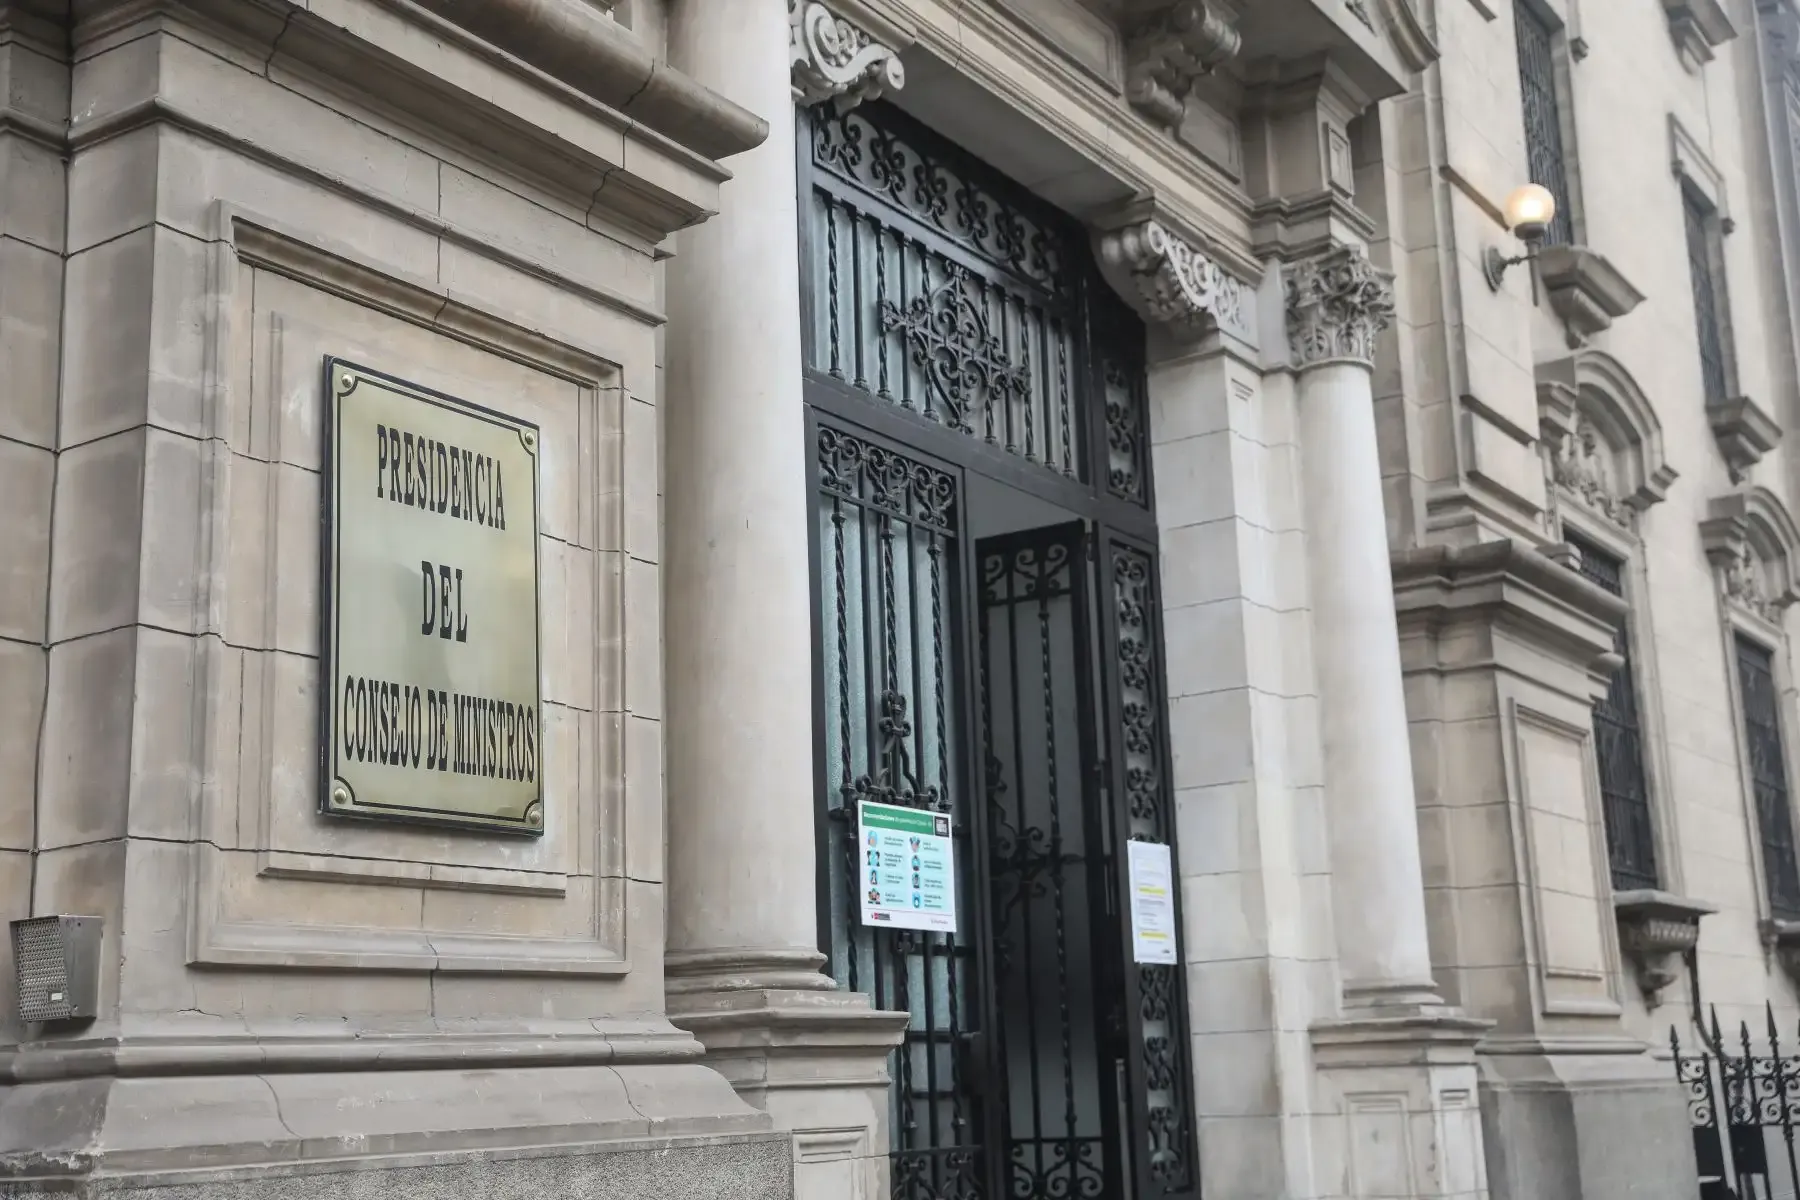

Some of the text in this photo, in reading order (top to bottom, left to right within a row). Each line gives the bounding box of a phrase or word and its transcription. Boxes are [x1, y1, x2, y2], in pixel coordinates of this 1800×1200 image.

[378, 424, 506, 531] PRESIDENCIA
[421, 561, 468, 643] DEL
[343, 674, 536, 784] CONSEJO DE MINISTROS
